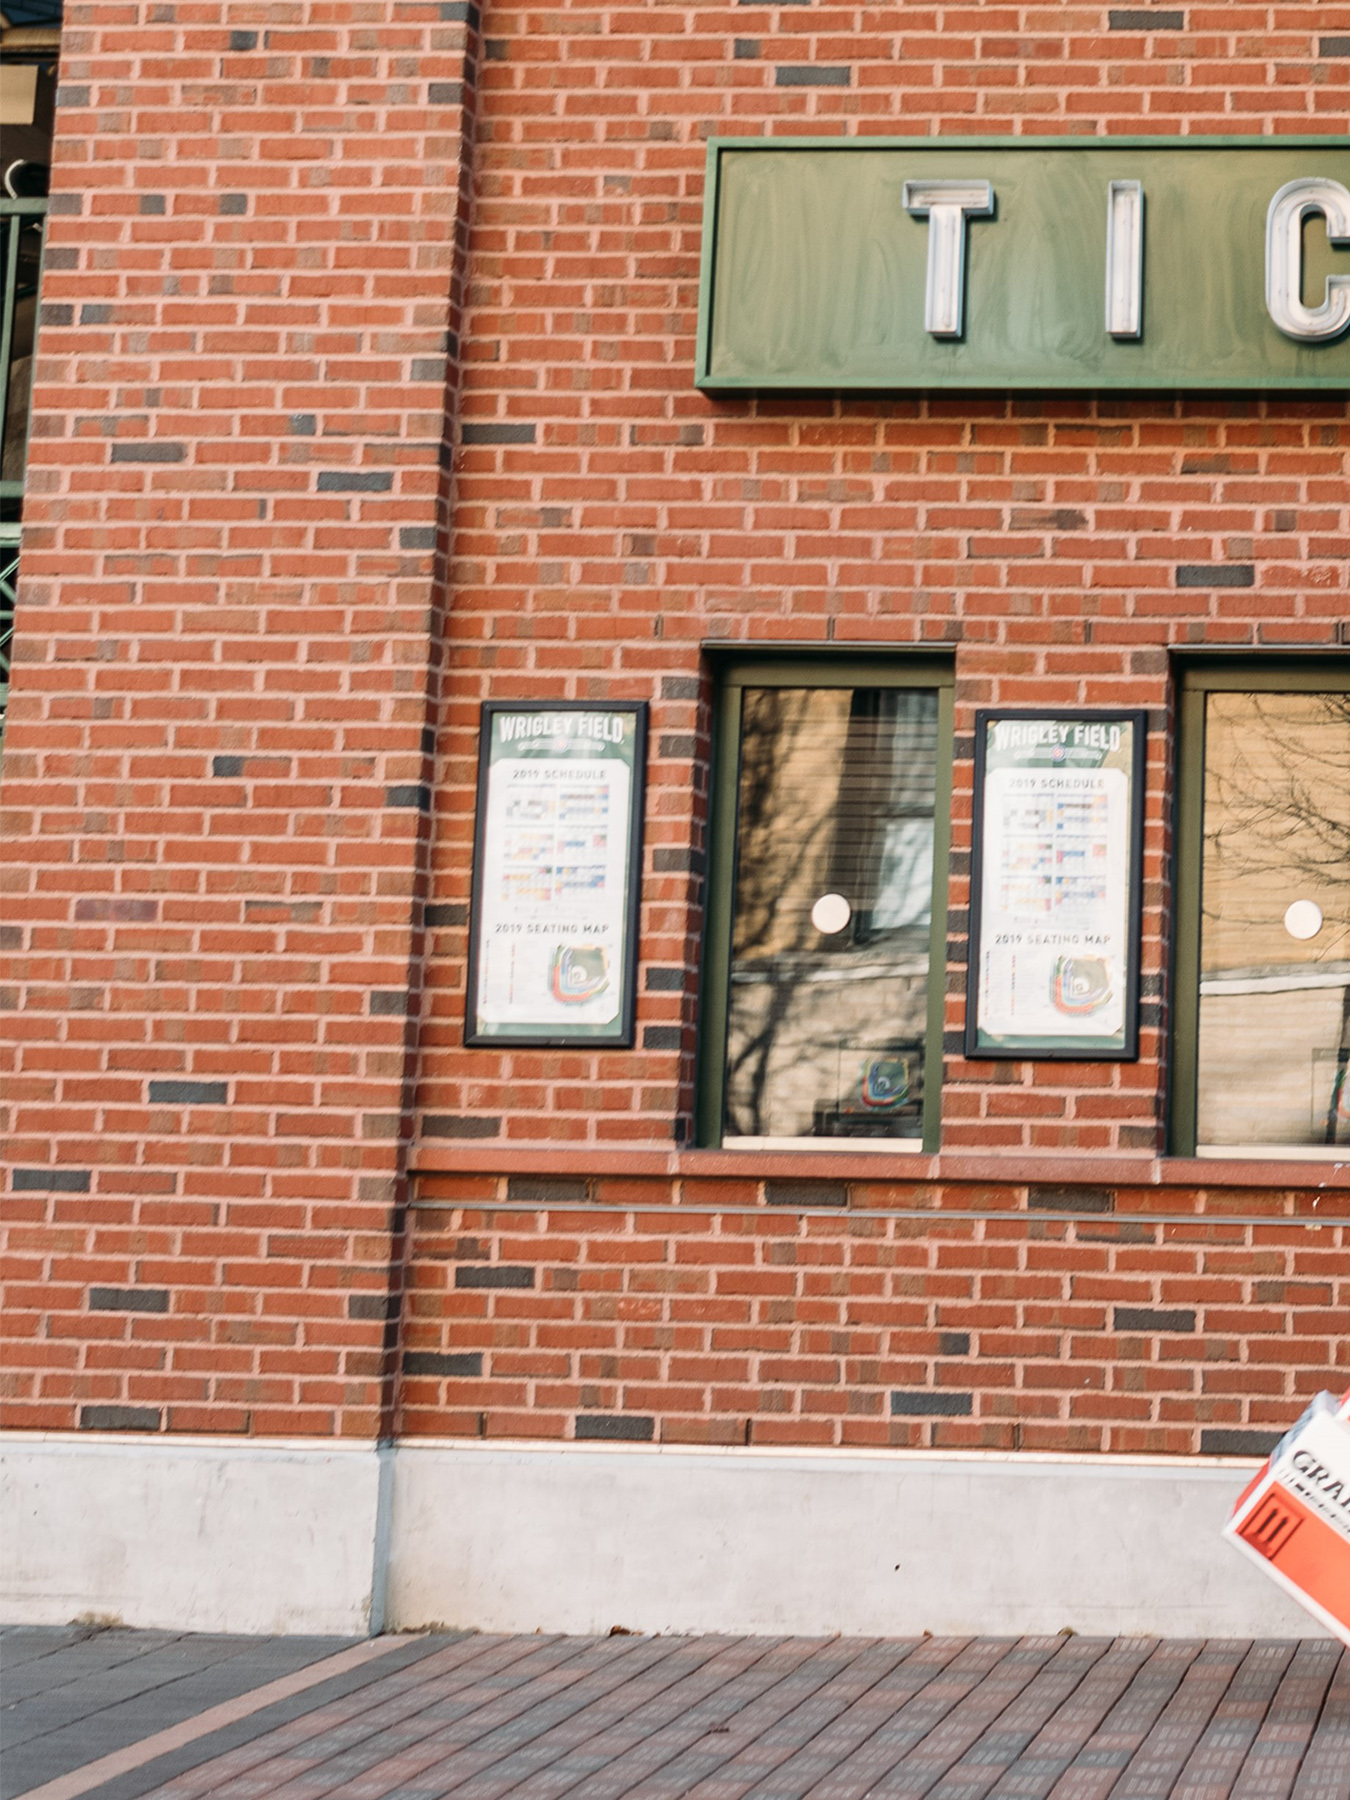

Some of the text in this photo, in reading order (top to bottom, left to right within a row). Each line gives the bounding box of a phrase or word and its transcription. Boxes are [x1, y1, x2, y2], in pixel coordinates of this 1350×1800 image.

[500, 715, 624, 743] WRIGLEY FIELD
[994, 724, 1121, 751] WRIGLEY FIELD
[513, 769, 607, 780] 2019 SCHEDULE
[1009, 778, 1105, 789] 2019 SCHEDULE
[495, 923, 522, 933] 2019
[582, 924, 609, 934] MAP
[995, 934, 1023, 944] 2019
[1085, 935, 1112, 945] MAP
